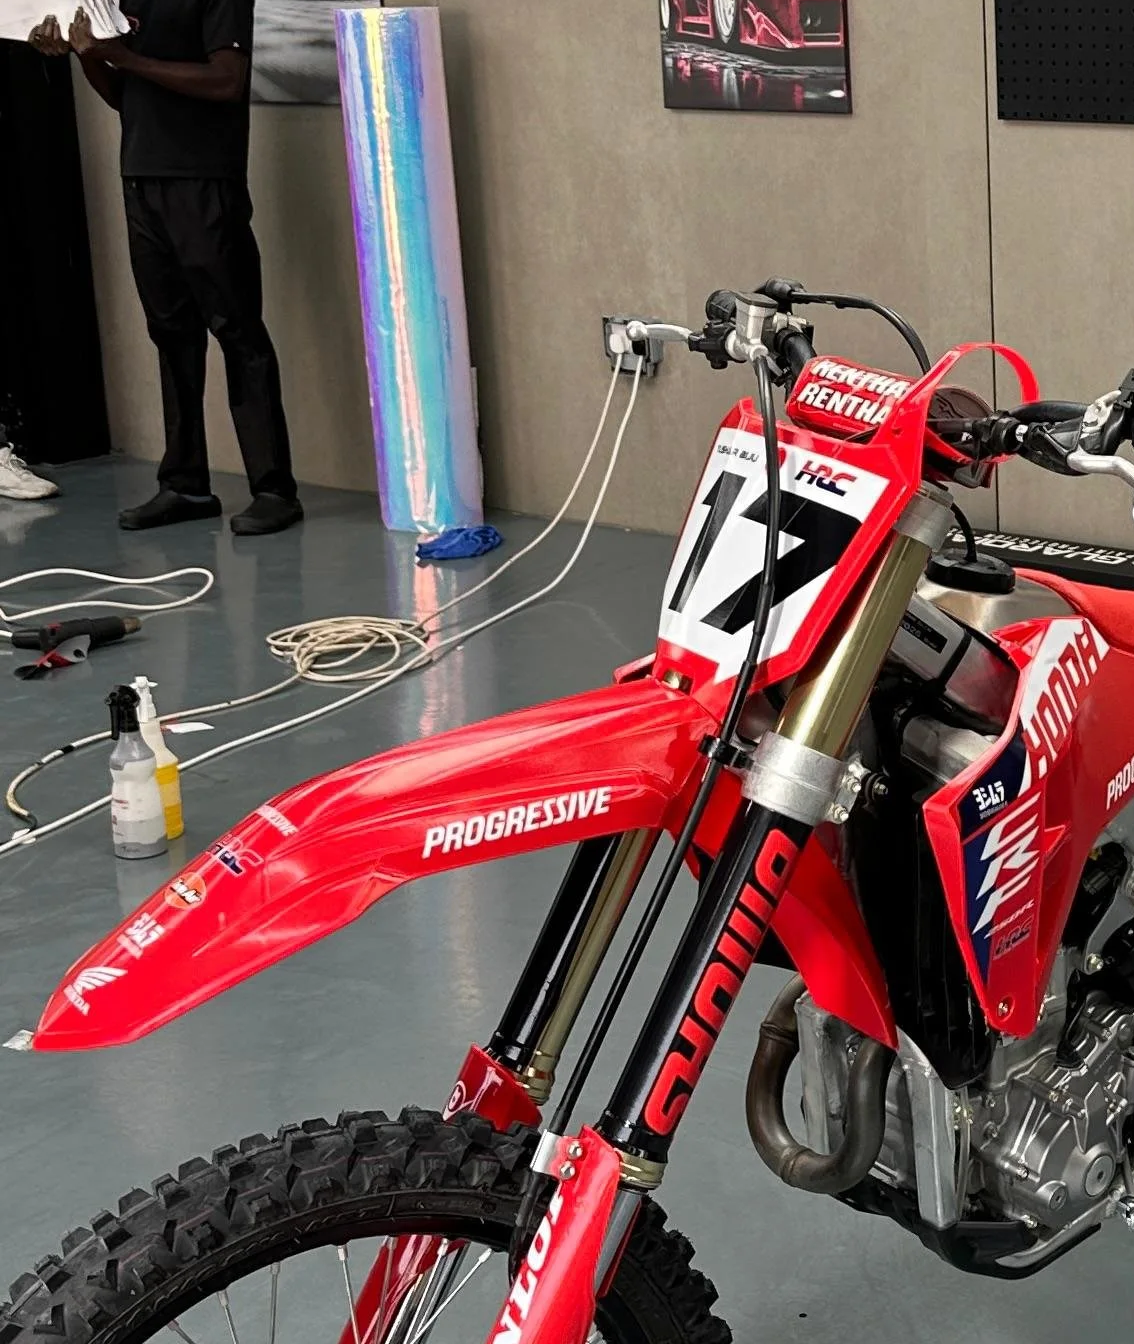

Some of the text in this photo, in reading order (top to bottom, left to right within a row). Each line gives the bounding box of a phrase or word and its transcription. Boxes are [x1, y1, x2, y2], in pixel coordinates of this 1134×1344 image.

[810, 359, 911, 399] RENTHA
[797, 382, 894, 424] RENTHA
[795, 460, 857, 497] HRC
[668, 471, 863, 635] 17
[947, 528, 1129, 565] GUARDIA
[421, 786, 612, 859] PROGRESSIVE
